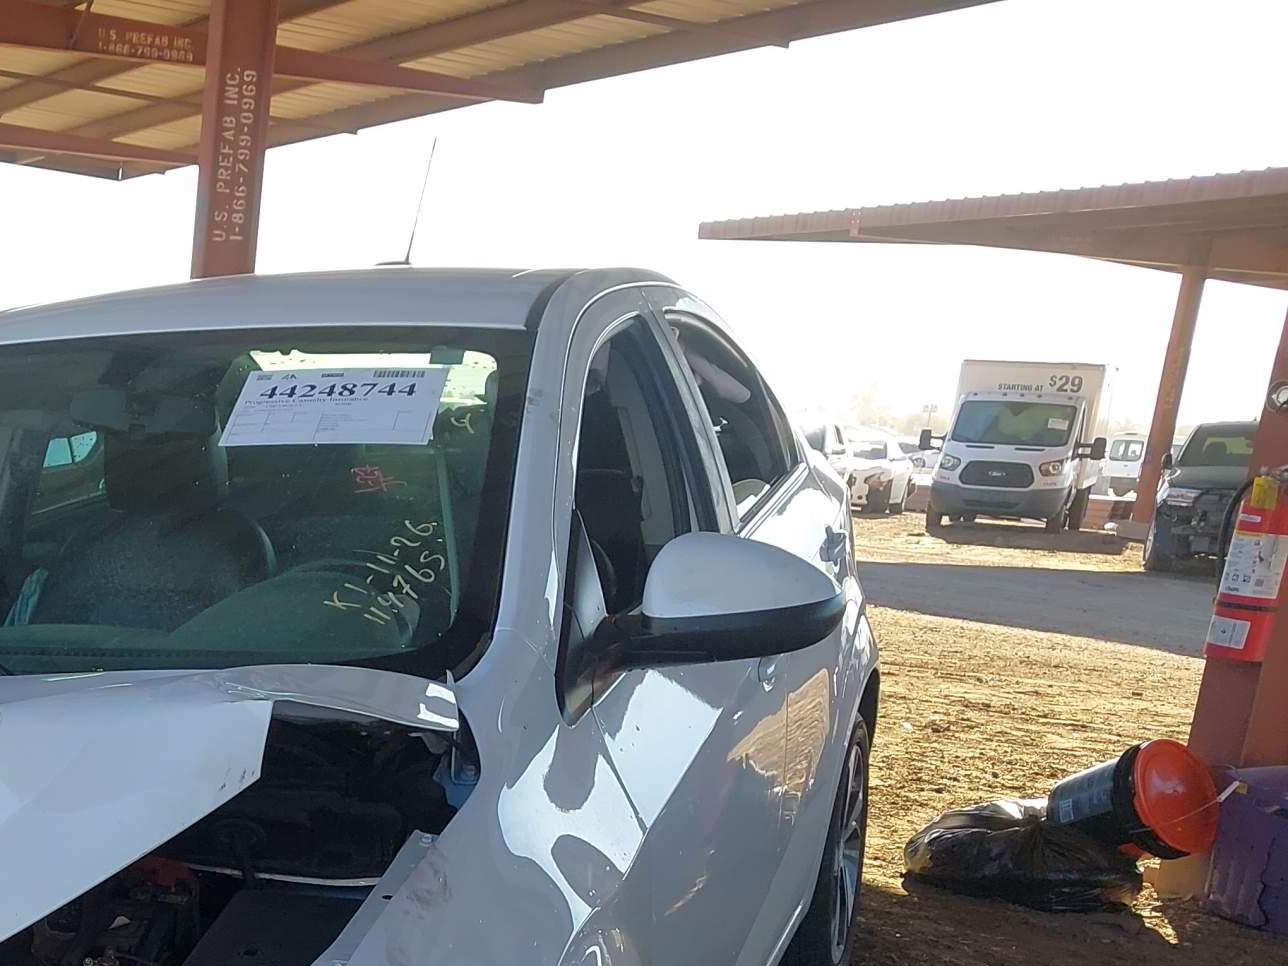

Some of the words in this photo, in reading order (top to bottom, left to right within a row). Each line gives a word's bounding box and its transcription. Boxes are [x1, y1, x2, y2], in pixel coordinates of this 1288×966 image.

[125, 31, 169, 47] PREFAB
[223, 66, 241, 105] INC.
[216, 116, 237, 193] PREFAB
[229, 69, 259, 241] 1-866-799-0969
[213, 206, 230, 241] U.S.
[260, 382, 417, 399] 44248744
[998, 383, 1033, 391] STARTING
[1034, 384, 1044, 392] AT
[1048, 375, 1083, 393] $29
